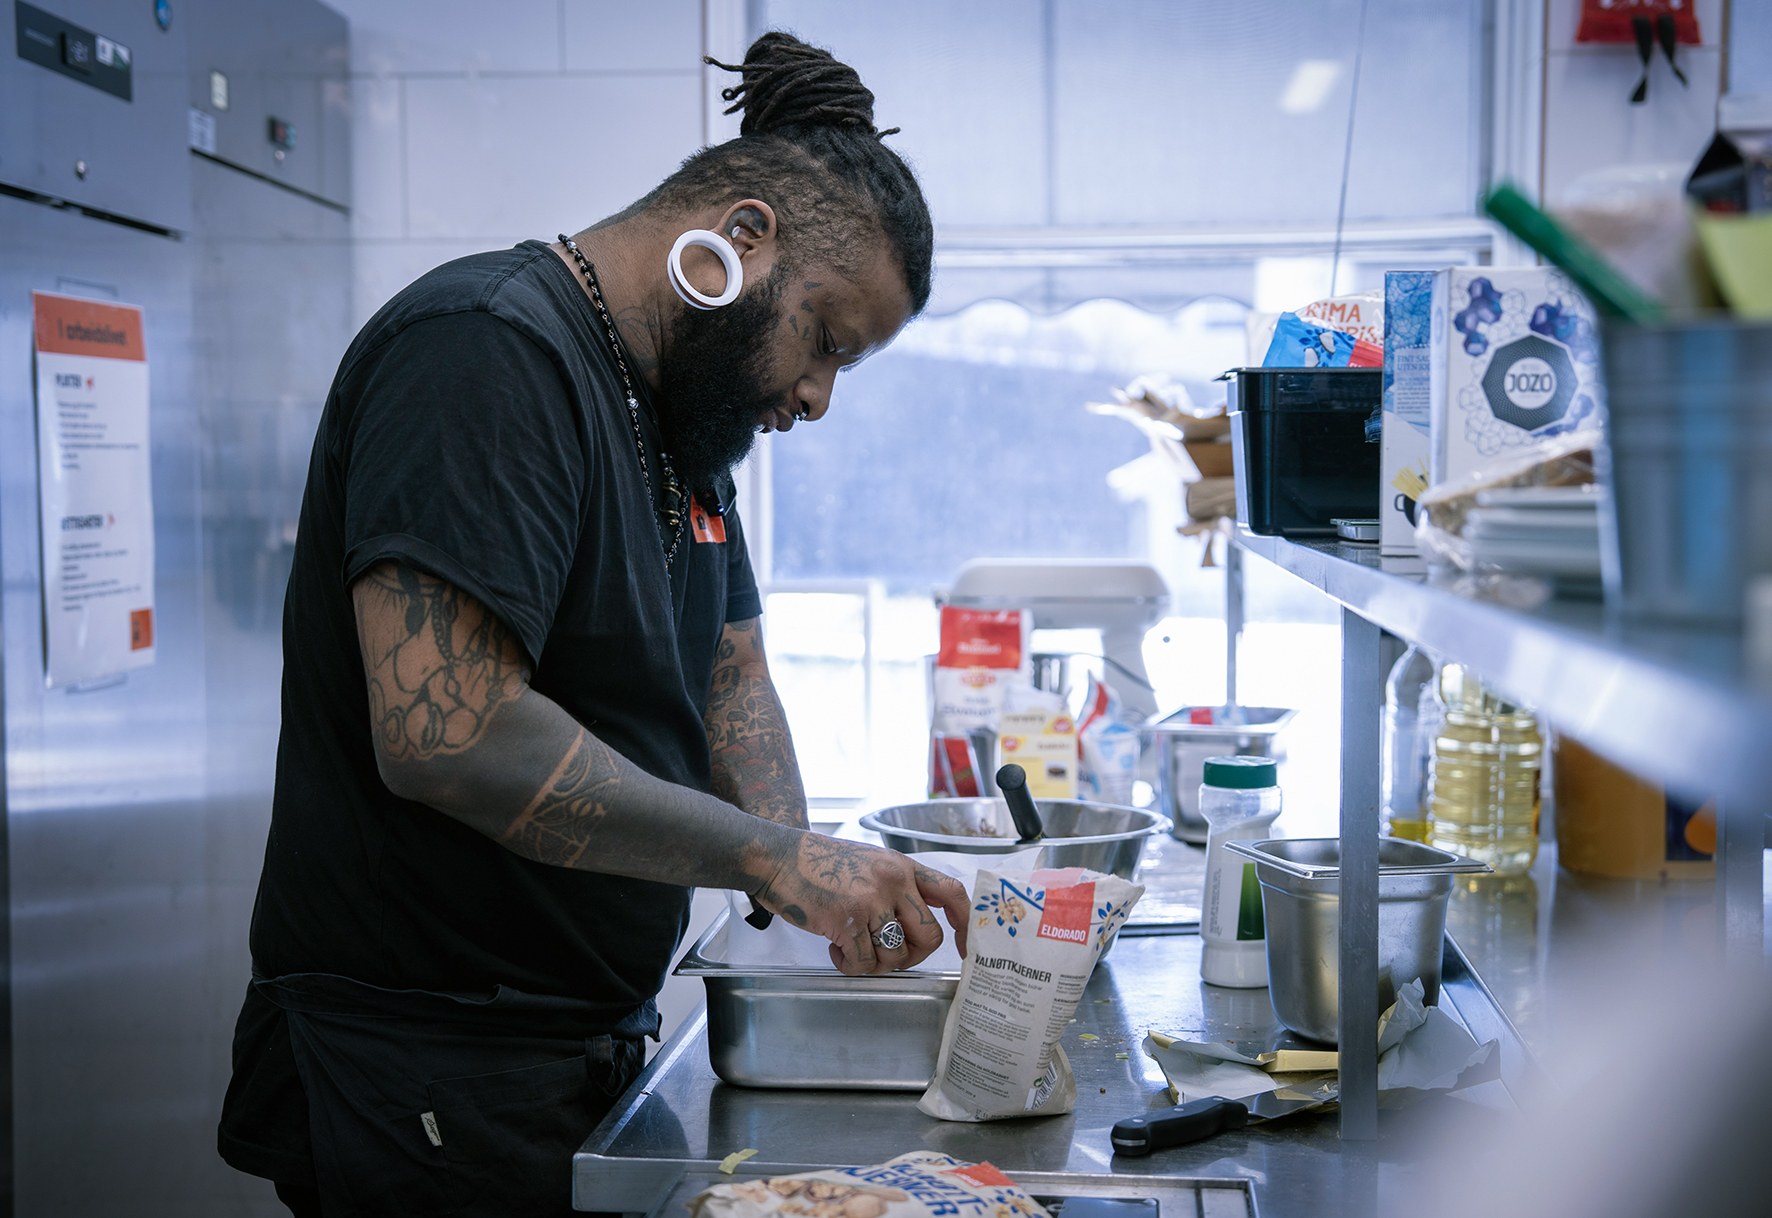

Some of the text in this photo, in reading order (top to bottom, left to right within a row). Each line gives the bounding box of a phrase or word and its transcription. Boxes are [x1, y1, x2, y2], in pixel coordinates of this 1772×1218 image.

[1508, 373, 1553, 393] JOZO
[1041, 924, 1087, 942] ELDORADO
[975, 953, 1052, 983] VALNØTTKJERNER
